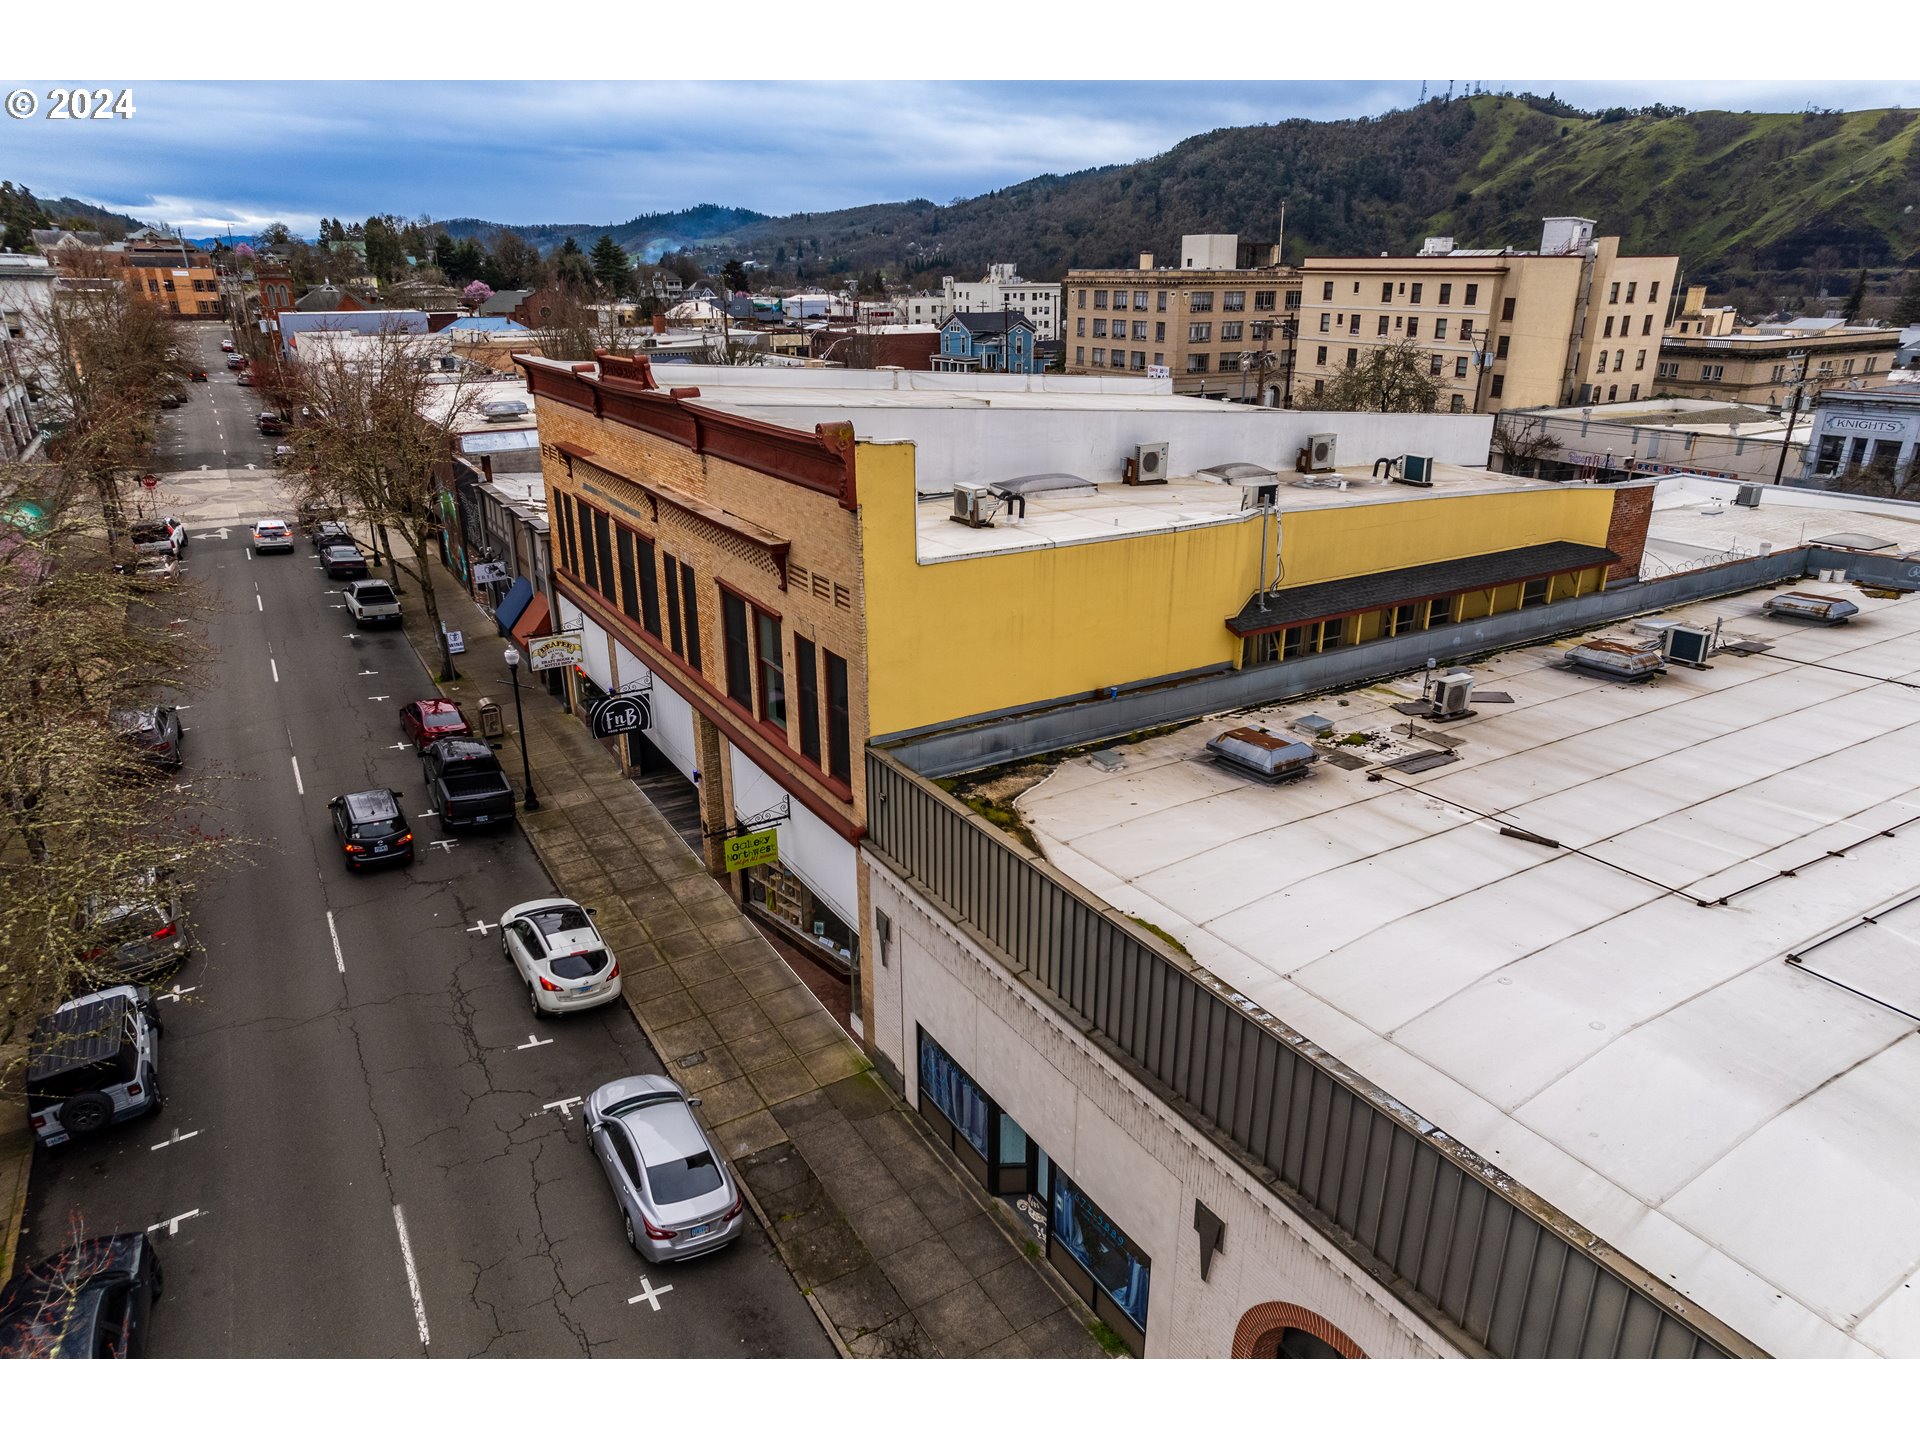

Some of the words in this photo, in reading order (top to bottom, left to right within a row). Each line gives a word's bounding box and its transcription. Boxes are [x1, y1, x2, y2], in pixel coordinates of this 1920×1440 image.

[1836, 419, 1897, 431] KNIGHTS
[540, 640, 573, 653] DRAPER
[606, 708, 637, 729] FnB
